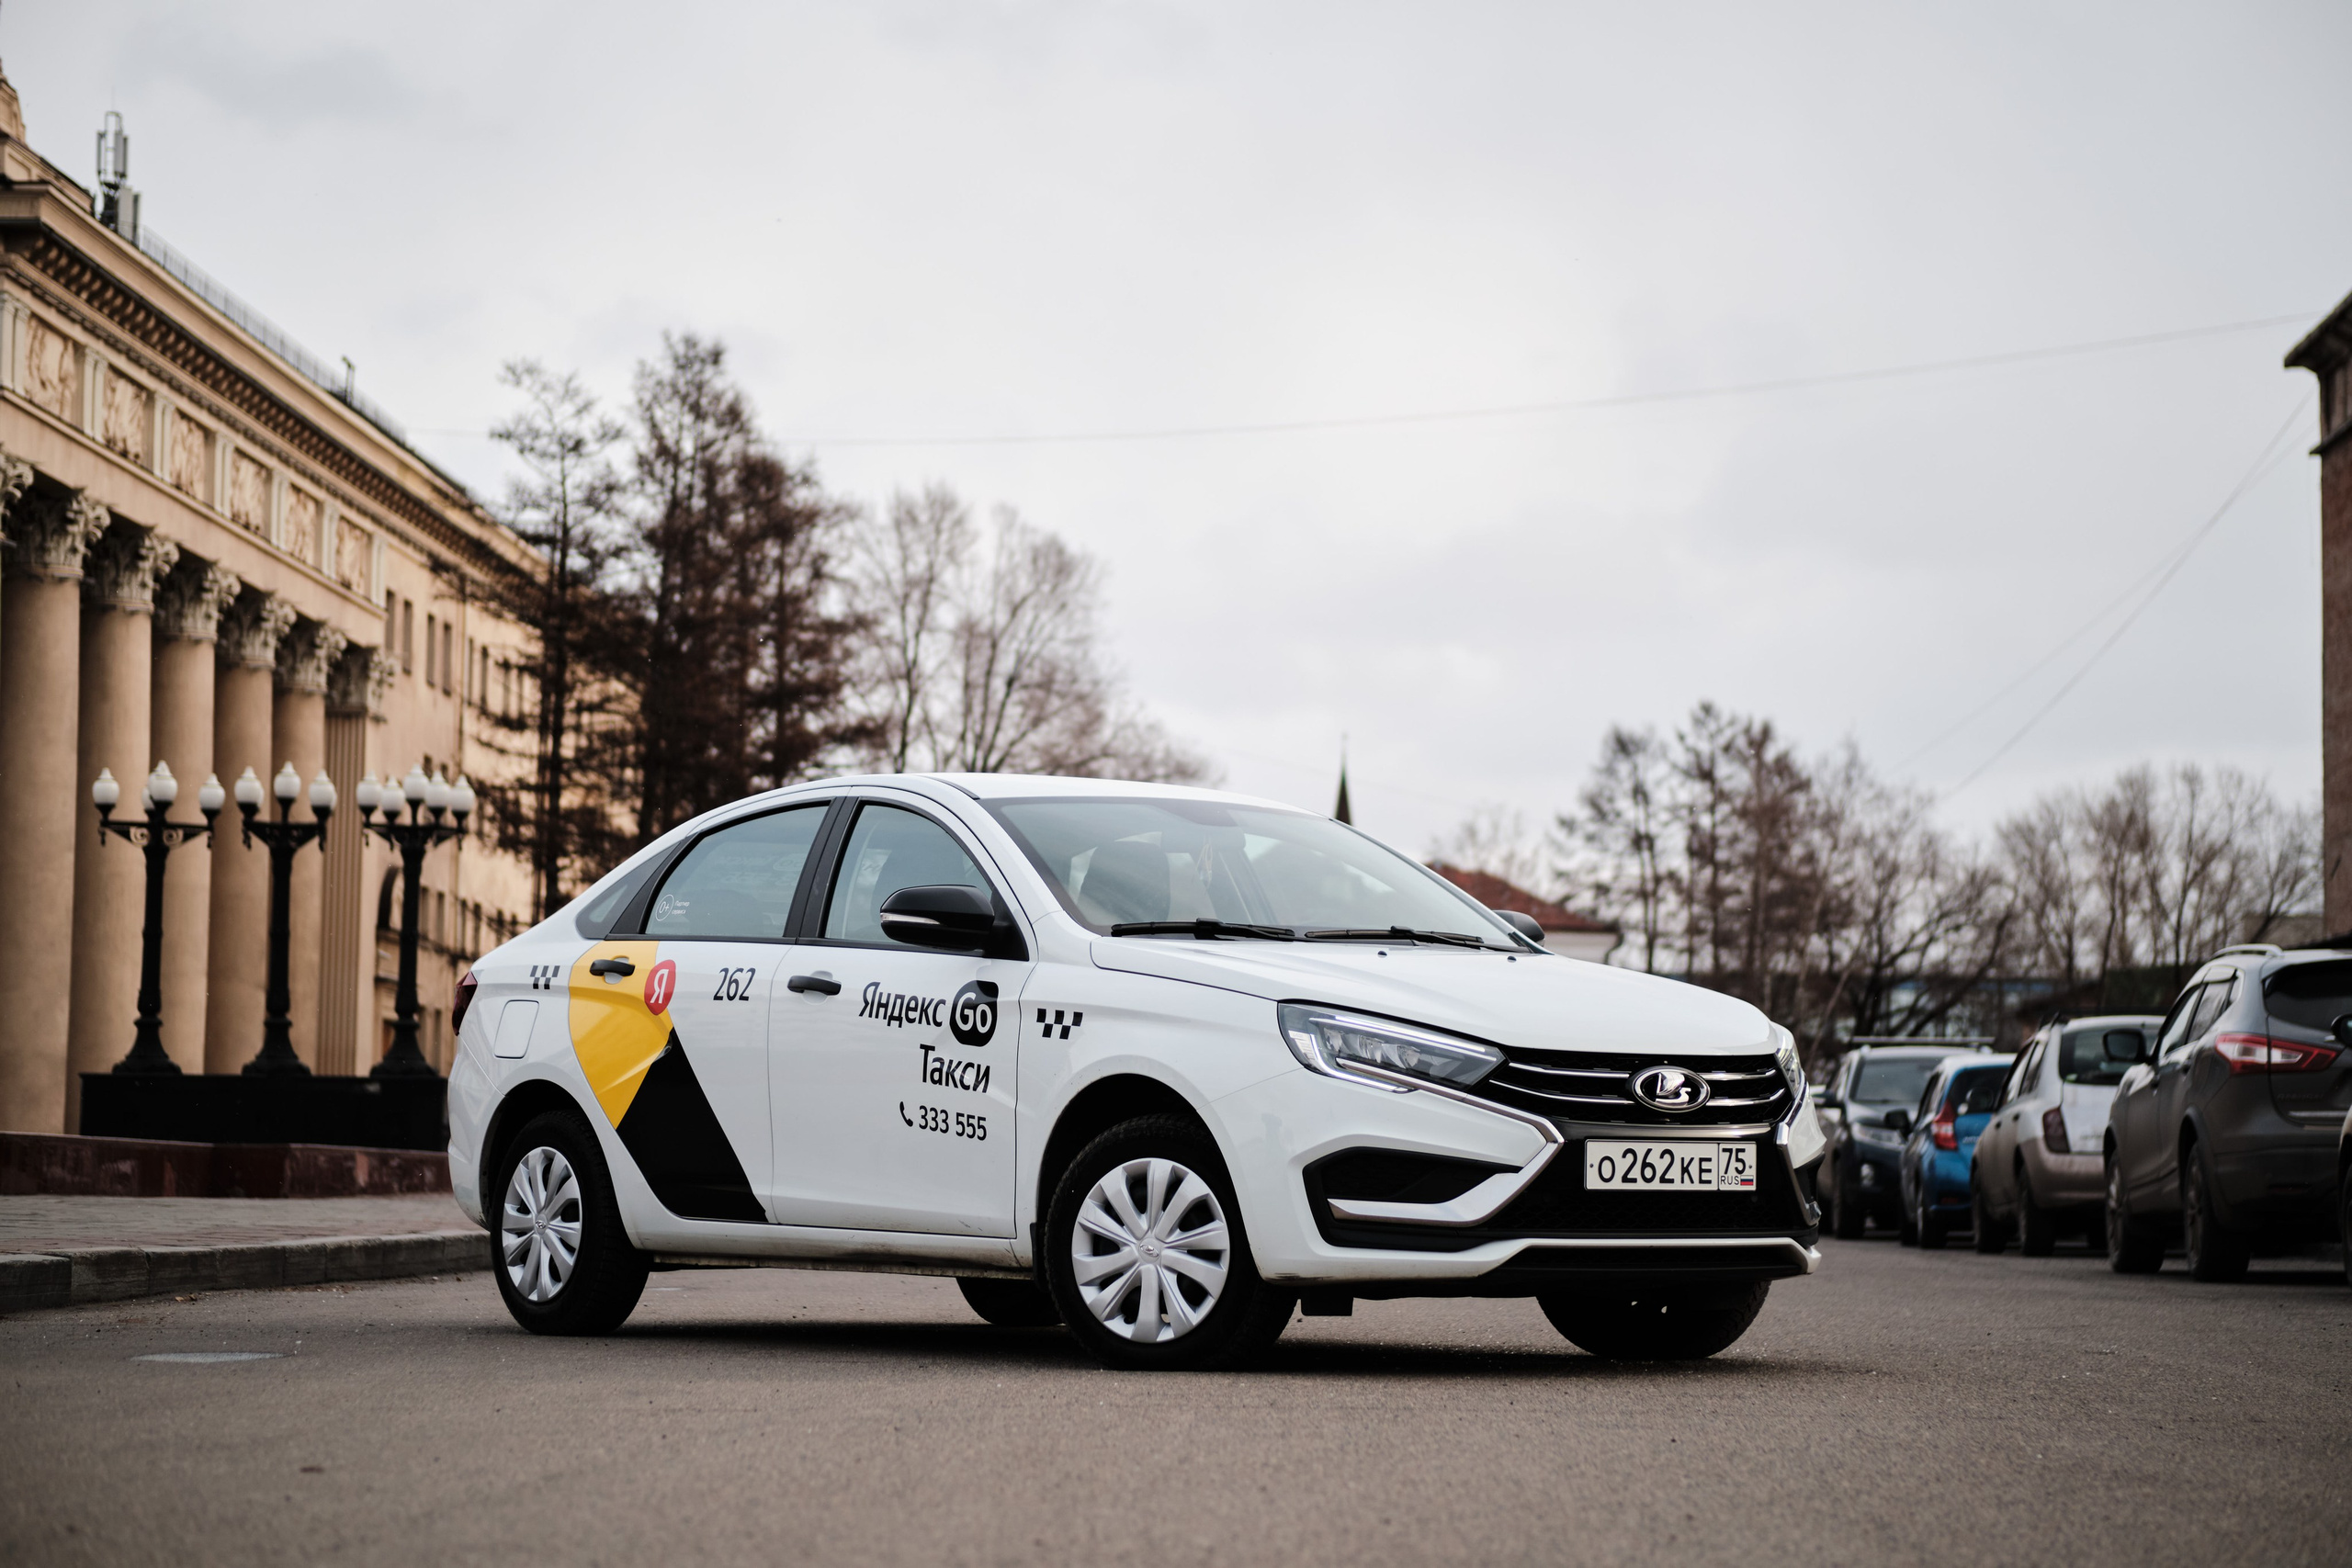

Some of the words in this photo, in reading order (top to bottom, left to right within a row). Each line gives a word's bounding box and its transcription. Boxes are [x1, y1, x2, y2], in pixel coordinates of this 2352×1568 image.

[650, 968, 669, 1004] Я
[713, 967, 756, 1001] 262
[859, 981, 946, 1028] Яндекс
[955, 991, 992, 1033] Go
[920, 1043, 990, 1093] Такси
[919, 1105, 949, 1134] 333
[956, 1111, 987, 1141] 555
[1722, 1147, 1747, 1175] 75
[1720, 1175, 1740, 1185] RUS
